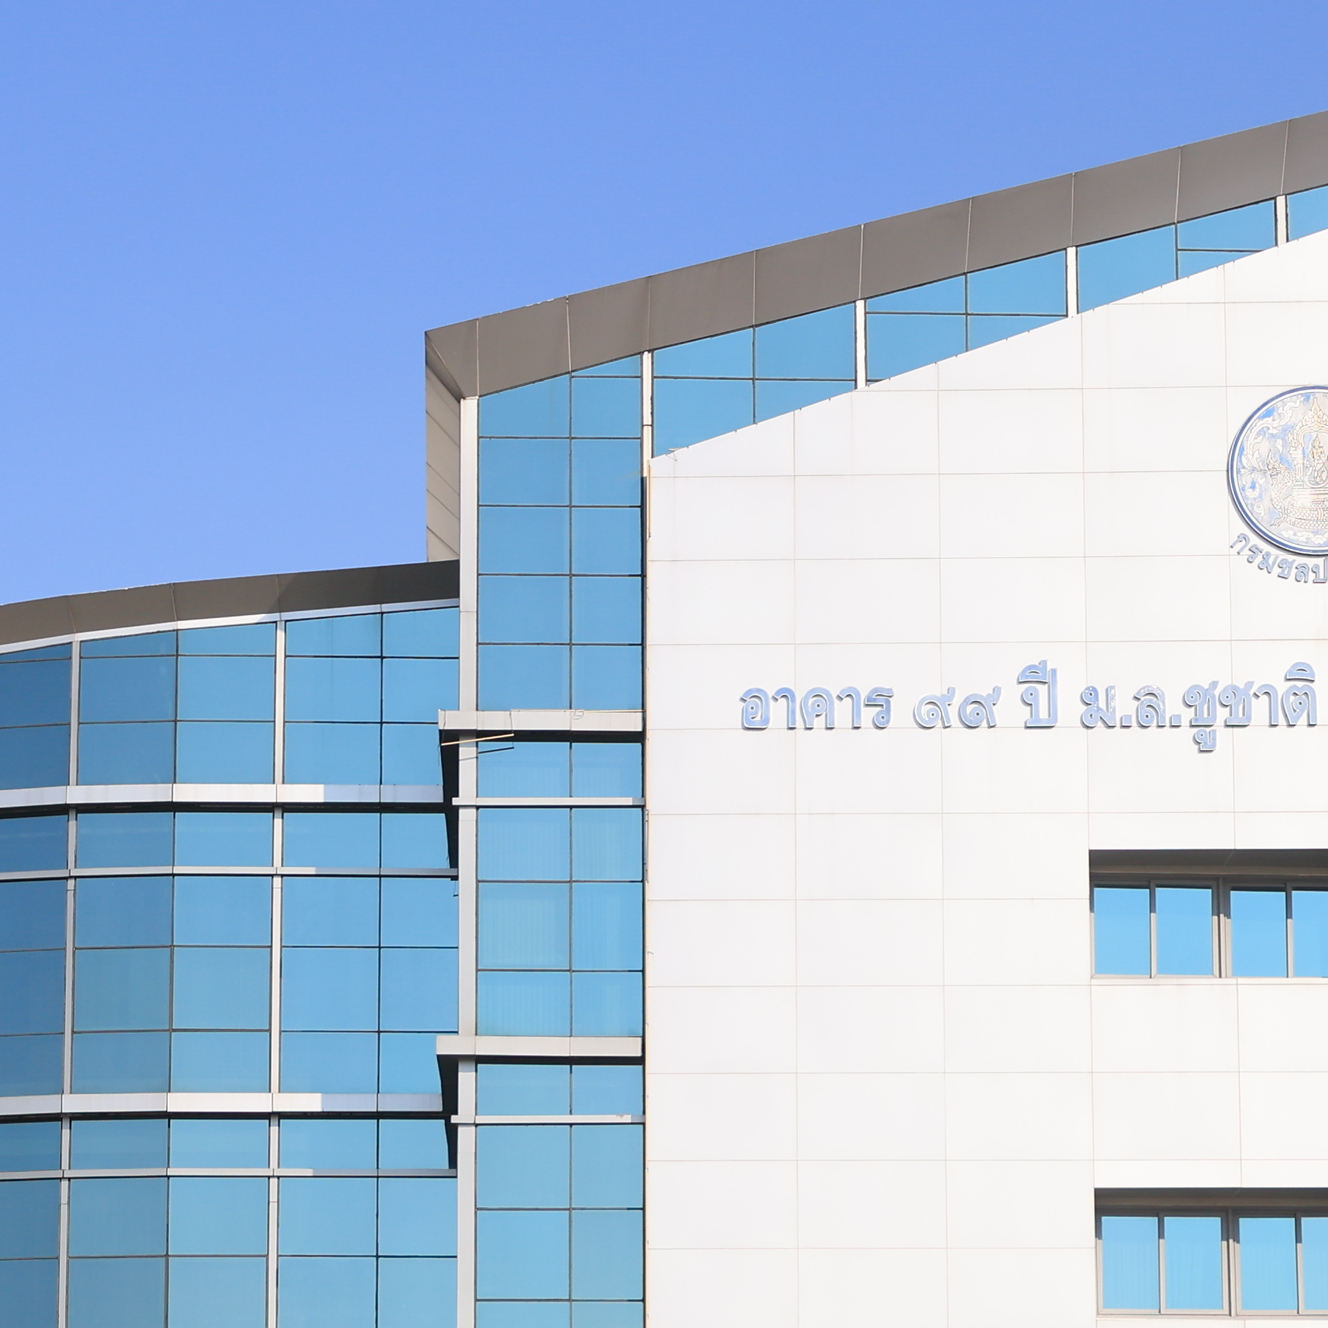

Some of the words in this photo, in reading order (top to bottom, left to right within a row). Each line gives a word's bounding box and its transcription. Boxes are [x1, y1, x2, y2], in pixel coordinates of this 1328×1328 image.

[741, 686, 894, 730] อาคาร
[914, 686, 1002, 730] ๙๙
[1017, 659, 1059, 730] ปี
[1080, 661, 1317, 753] ม.ล.ชูชาติ
